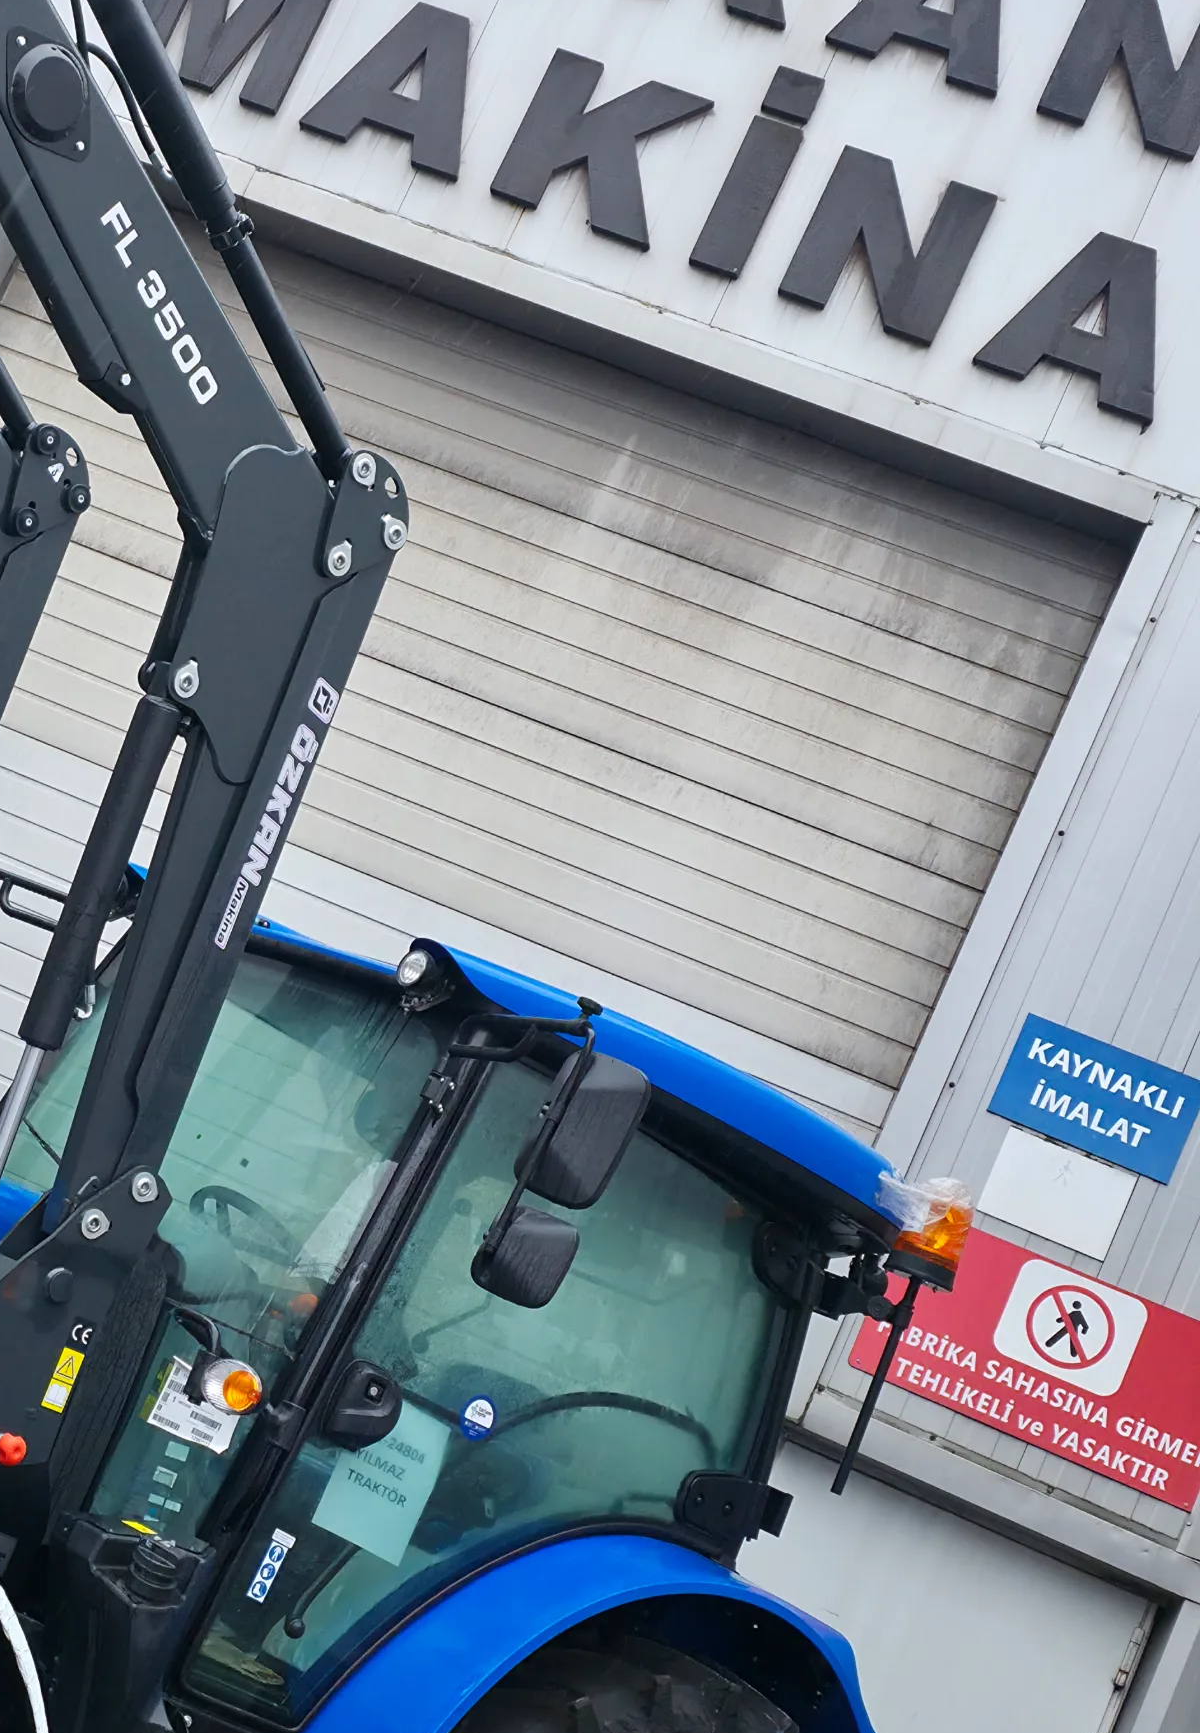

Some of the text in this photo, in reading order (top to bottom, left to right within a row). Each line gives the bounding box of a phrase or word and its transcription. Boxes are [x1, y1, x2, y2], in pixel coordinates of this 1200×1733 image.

[100, 201, 218, 405] FL 3500
[216, 723, 320, 946] ÖZKAN Makina
[1027, 1037, 1186, 1118] KAYNAKLI
[1029, 1078, 1151, 1148] İMALAT
[896, 1357, 1169, 1491] TEHLİKELİ ve YASAKTIR
[983, 1360, 1108, 1428] SAHASINA
[1116, 1416, 1200, 1468] GİRME
[347, 1468, 407, 1508] TRAKTÖR
[357, 1448, 406, 1481] YILMAZ
